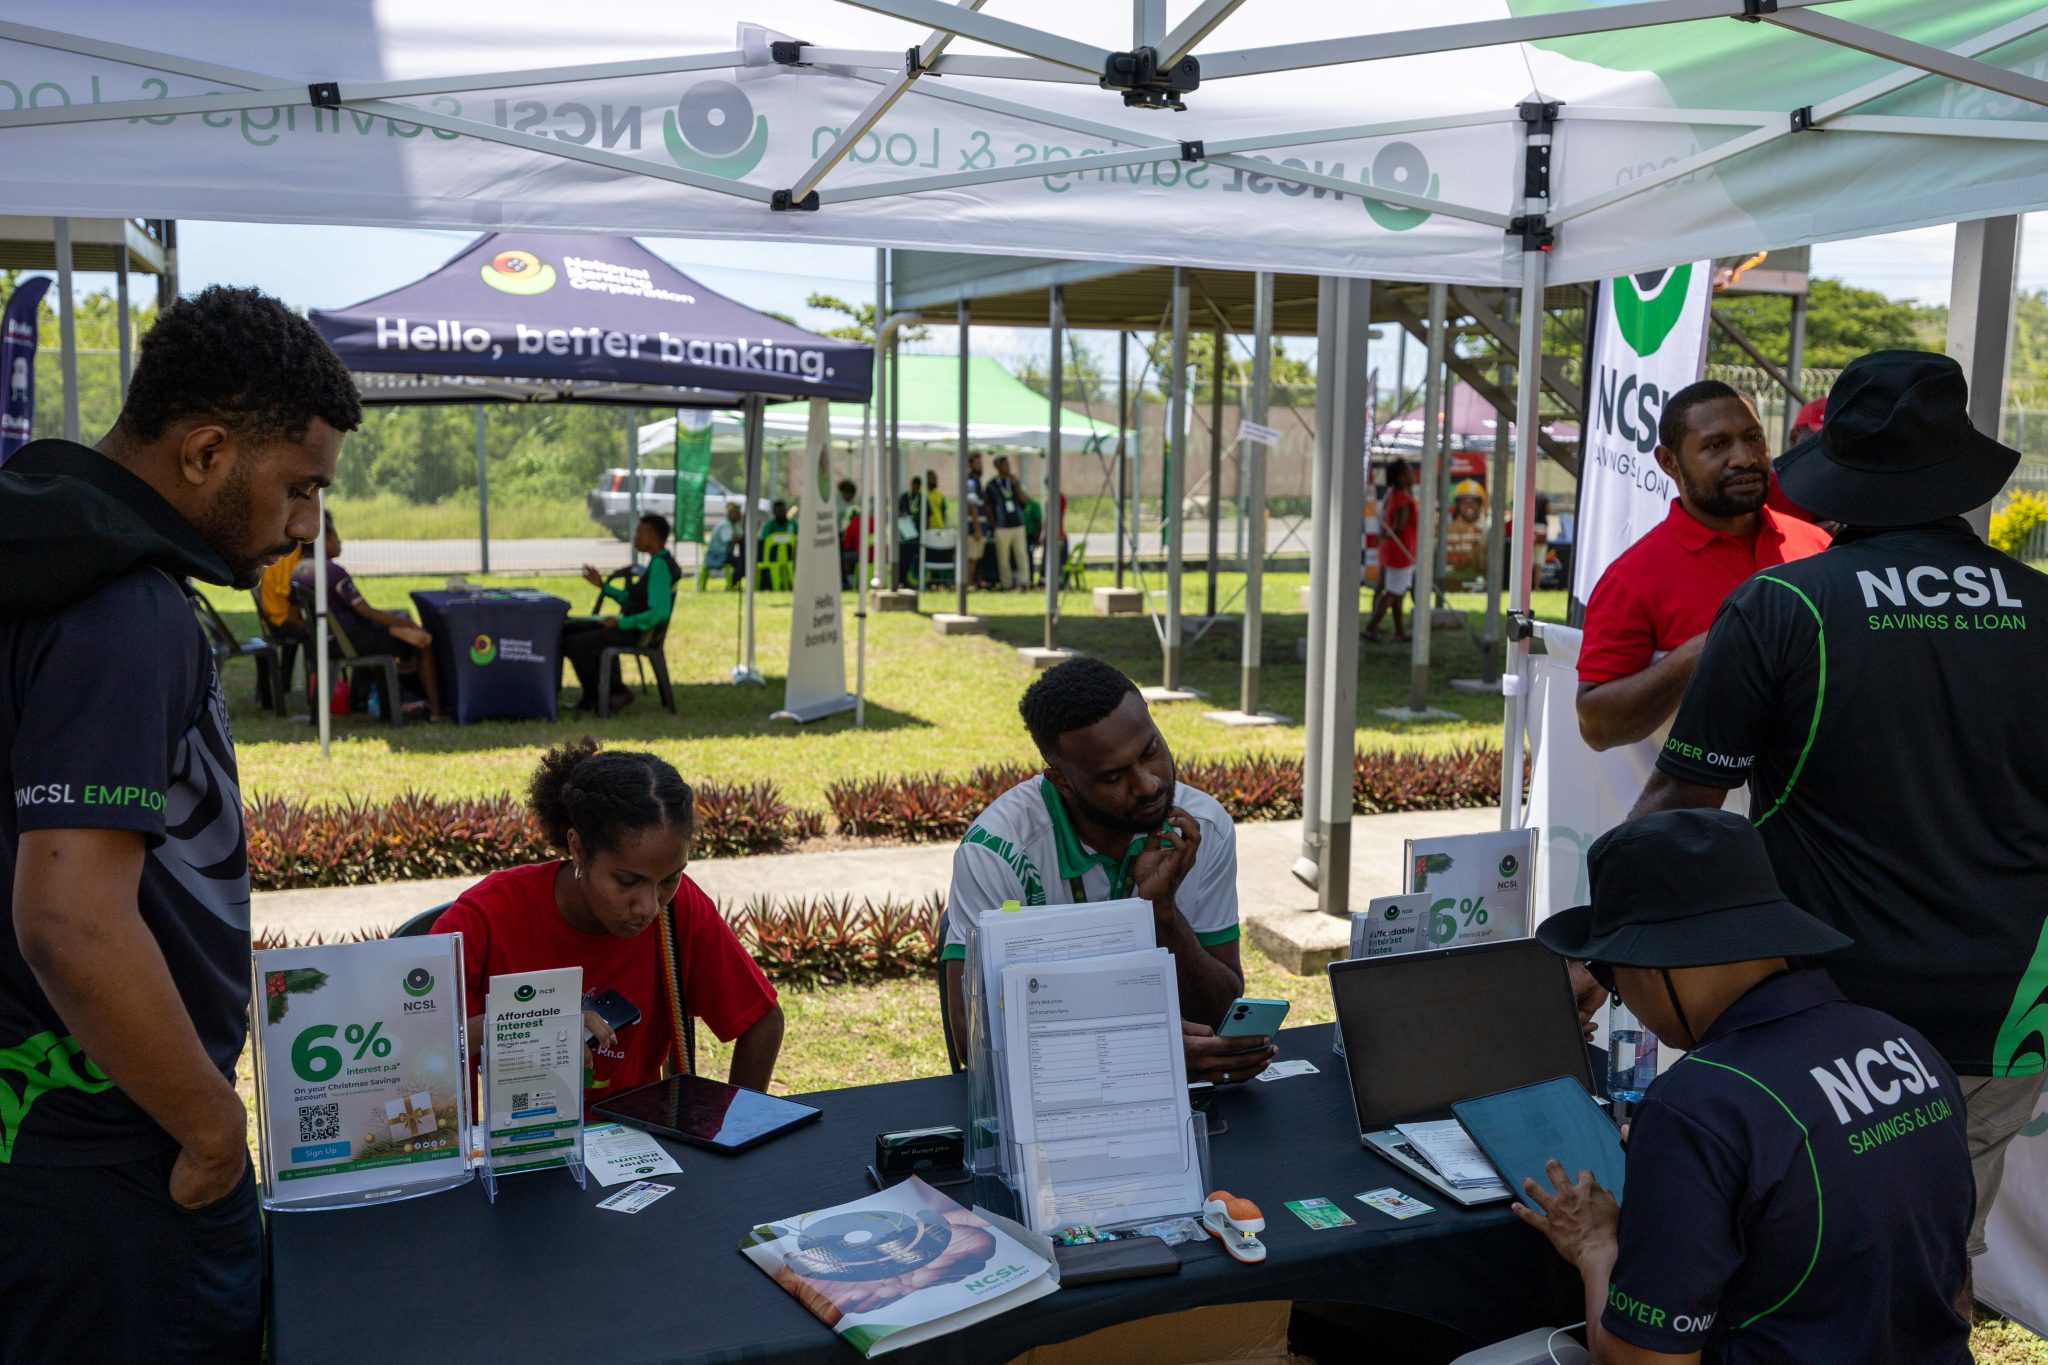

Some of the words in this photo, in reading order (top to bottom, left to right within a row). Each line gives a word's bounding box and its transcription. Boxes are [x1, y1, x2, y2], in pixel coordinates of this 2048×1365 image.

[376, 316, 503, 361] Hello,
[517, 323, 647, 360] better
[659, 331, 835, 383] banking.
[1856, 565, 2023, 608] NCSL
[1868, 613, 1949, 631] SAVINGS
[1954, 616, 1969, 630] &
[1974, 613, 2027, 631] LOAN
[1707, 752, 1756, 768] ONLINE
[1497, 880, 1518, 890] NCSL
[1429, 896, 1488, 945] 6%
[1458, 930, 1481, 939] interest
[403, 1000, 437, 1011] NCSL
[496, 1007, 561, 1022] Affordable
[496, 1019, 544, 1032] Interest
[496, 1031, 531, 1042] Rates
[291, 1021, 392, 1083] 6%
[346, 1065, 382, 1075] interest
[307, 1085, 327, 1095] your
[328, 1080, 369, 1091] Christmas
[370, 1077, 401, 1087] Savings
[1810, 1036, 1940, 1125] NCSL
[294, 1092, 327, 1102] account
[1848, 1112, 1915, 1155] SAVINGS
[1914, 1107, 1929, 1127] &
[305, 1149, 323, 1158] Sign
[325, 1147, 337, 1156] Up
[607, 1152, 660, 1165] Returns
[619, 1156, 664, 1168] Higher
[964, 1264, 1025, 1292] NCSL
